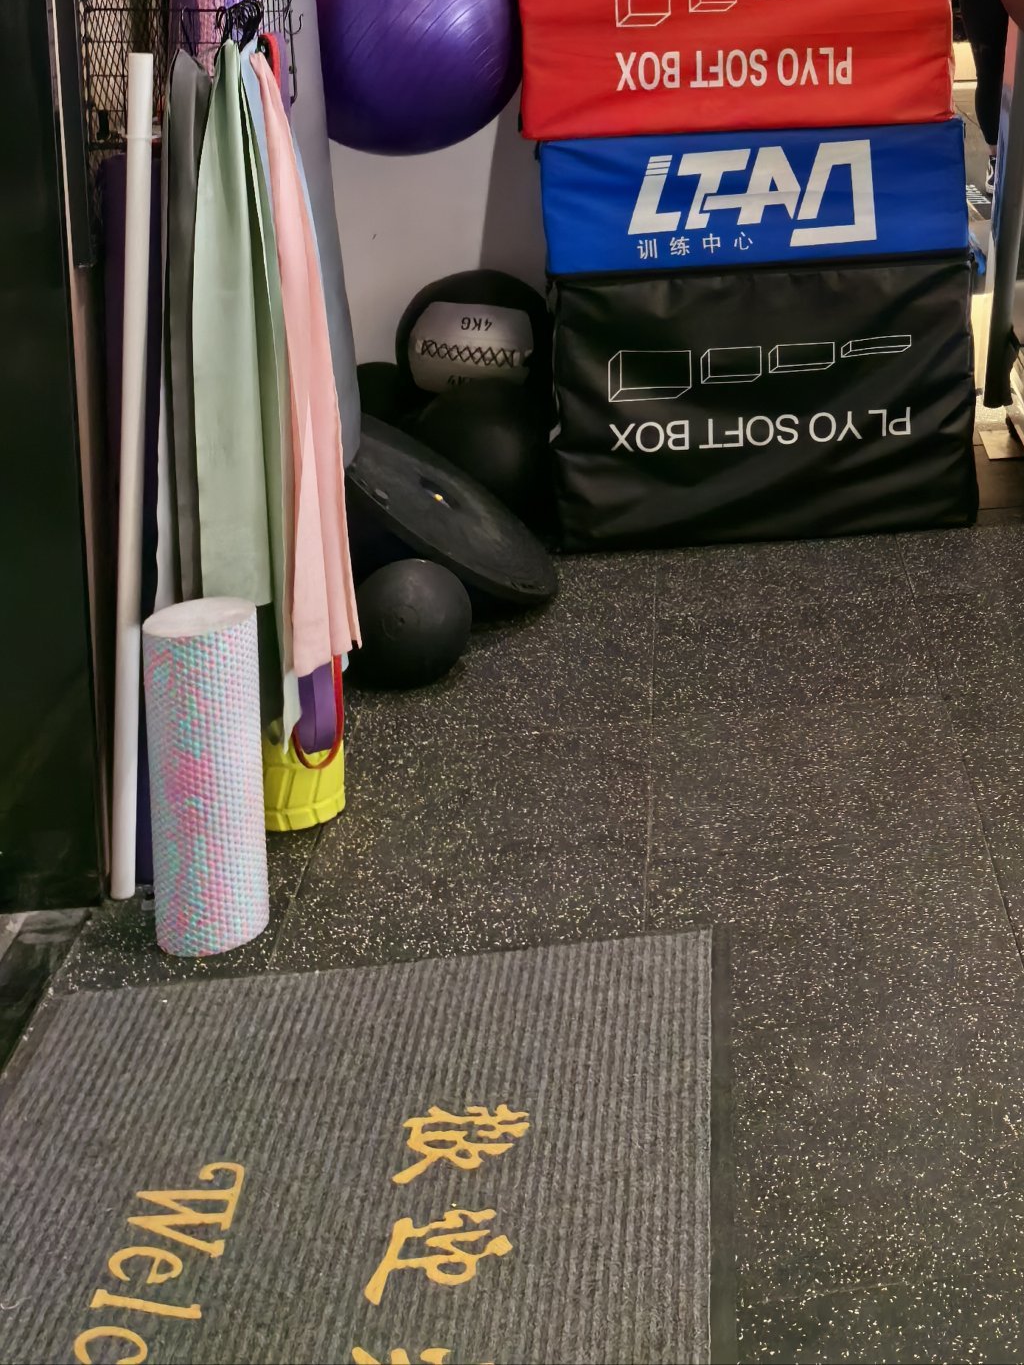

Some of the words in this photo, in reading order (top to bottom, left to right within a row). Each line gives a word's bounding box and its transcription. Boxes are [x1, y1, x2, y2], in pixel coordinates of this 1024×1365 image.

[616, 51, 680, 91] BOX
[690, 48, 767, 88] SOFT
[777, 47, 852, 86] PLYO
[637, 232, 753, 260] 训练中心
[461, 317, 493, 331] 4KG
[609, 419, 690, 453] BOX
[698, 413, 800, 450] SOFT
[74, 1162, 246, 1365] Welc
